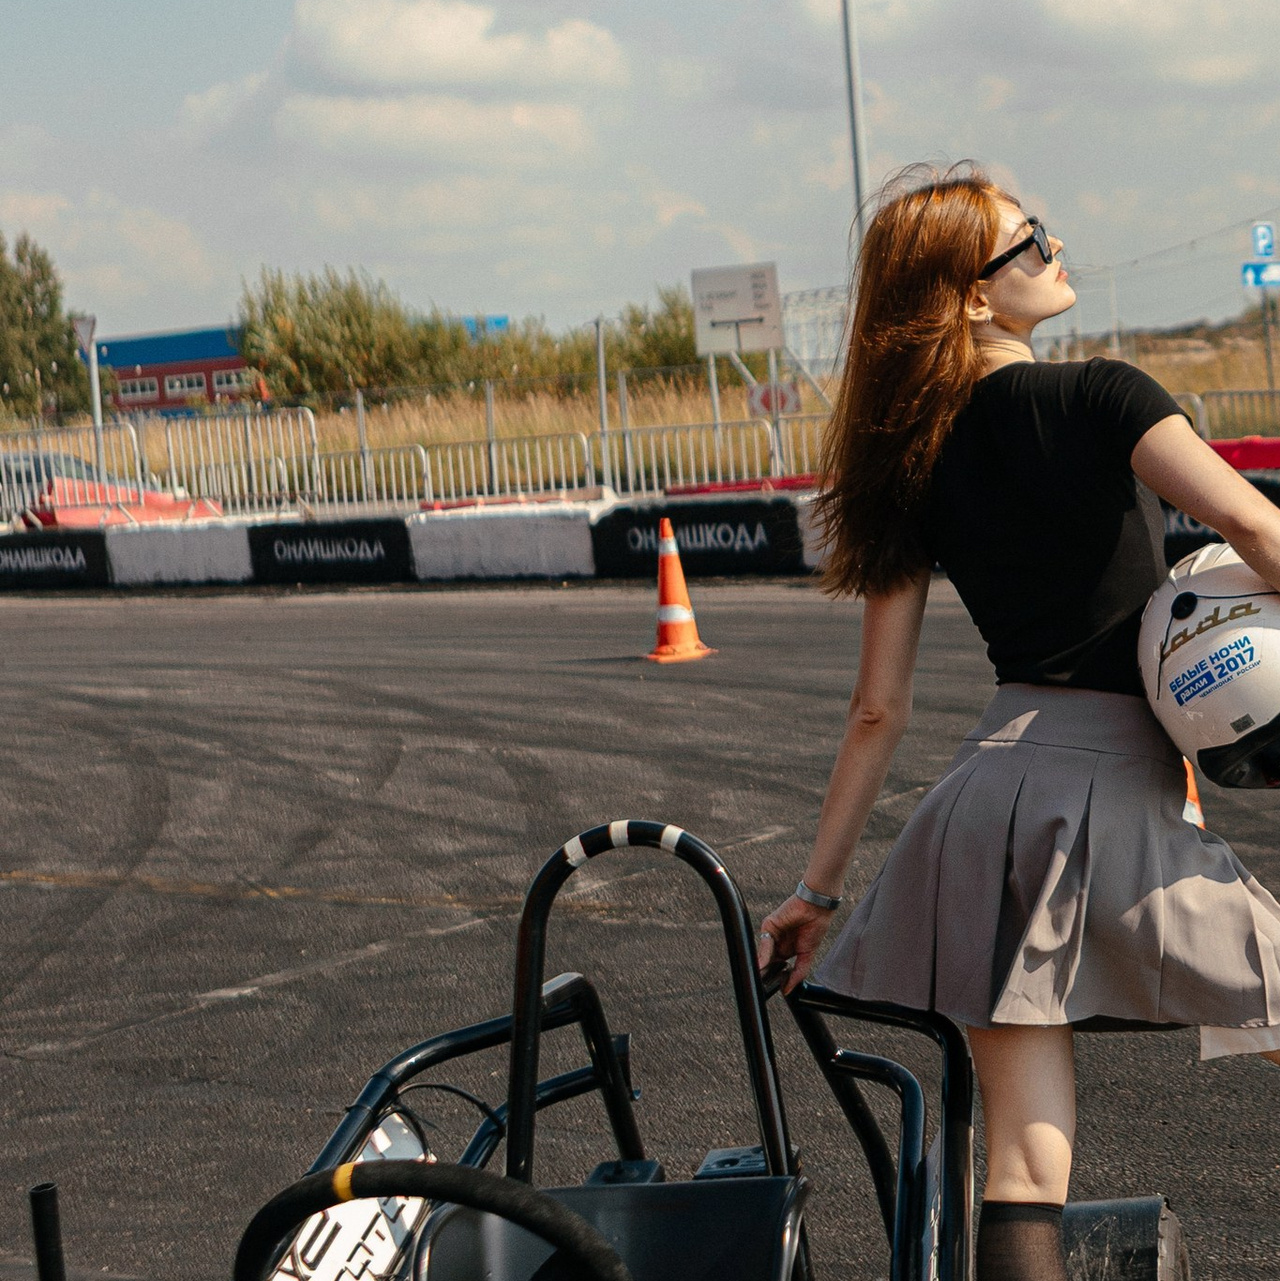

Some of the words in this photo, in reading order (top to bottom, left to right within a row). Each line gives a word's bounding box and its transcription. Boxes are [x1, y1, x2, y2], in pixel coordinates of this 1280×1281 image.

[1169, 659, 1208, 692] БЕЛЫЕ
[1208, 635, 1251, 664] НОЧИ
[1199, 675, 1234, 698] ЧЕМПИОНАТ
[1236, 660, 1261, 676] РОССИИ
[1214, 646, 1254, 679] 2017
